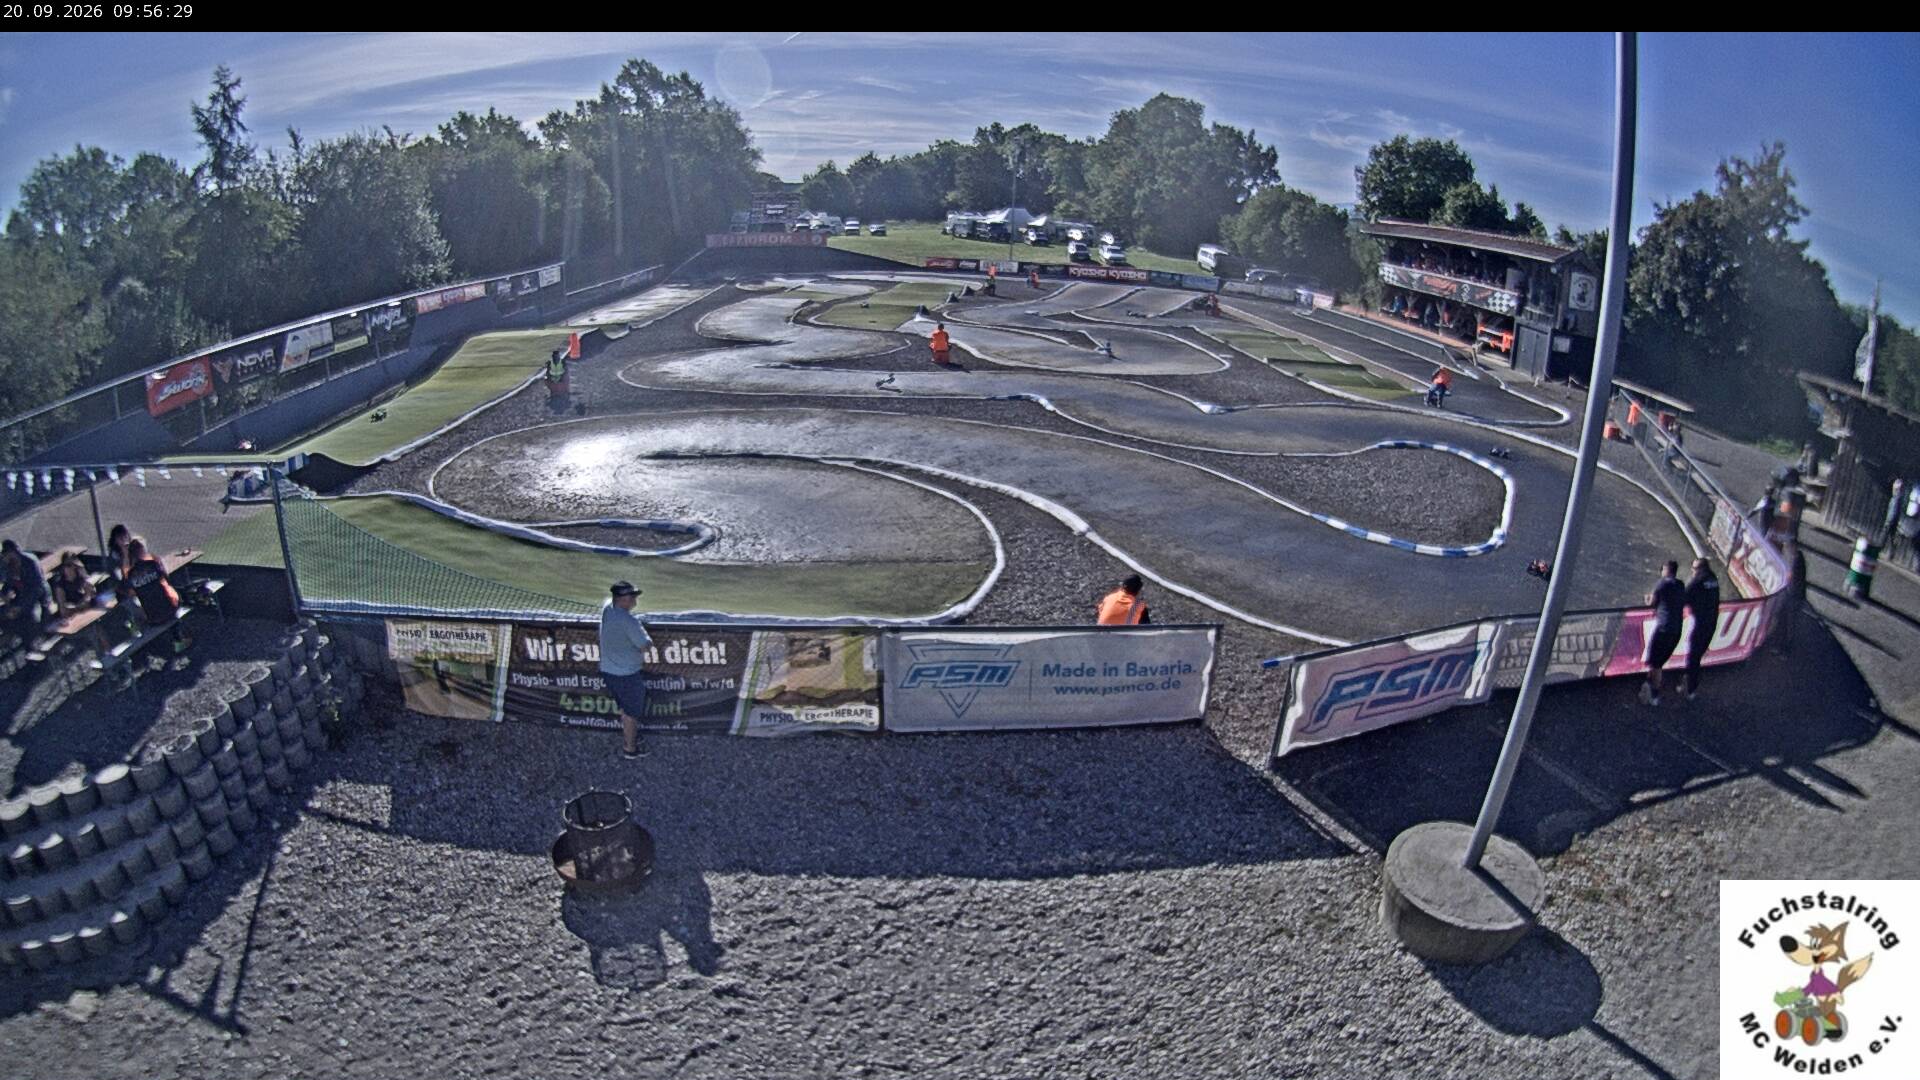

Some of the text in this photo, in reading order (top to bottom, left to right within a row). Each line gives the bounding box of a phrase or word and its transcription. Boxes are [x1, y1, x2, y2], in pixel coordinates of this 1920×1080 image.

[237, 348, 275, 370] NOVA
[524, 636, 728, 665] Wir sun dich!
[904, 662, 1016, 686] PSM
[1041, 659, 1197, 678] Made in Bavaria.
[512, 672, 554, 688] Physio-
[556, 674, 579, 687] und
[1053, 677, 1182, 697] www.psmco.de
[1307, 646, 1486, 728] PSM
[760, 707, 874, 723] PHYSIO ERGOTHERAPIE
